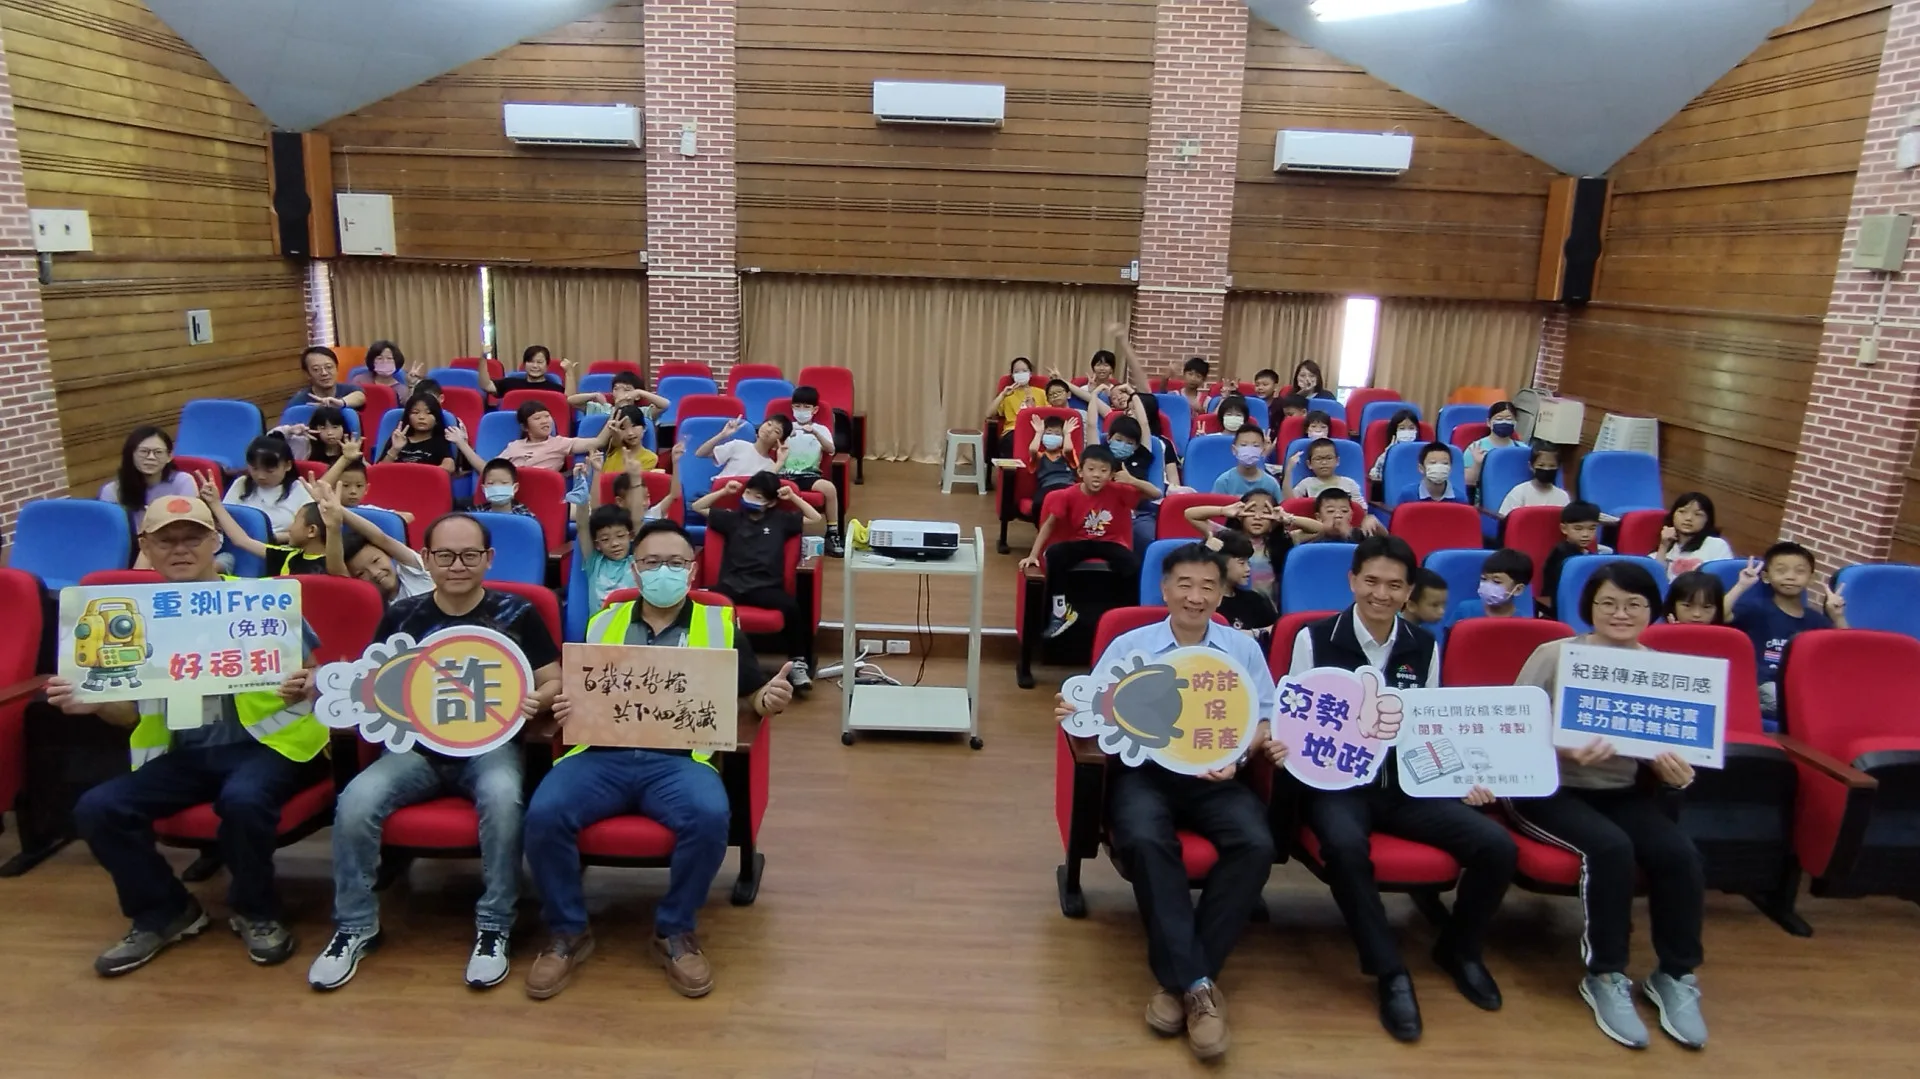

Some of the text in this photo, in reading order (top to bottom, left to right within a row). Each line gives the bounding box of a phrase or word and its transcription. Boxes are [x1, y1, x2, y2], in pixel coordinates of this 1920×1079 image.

[152, 589, 293, 619] 重測Free
[228, 618, 288, 638] (免費)
[168, 648, 281, 681] 好福利
[1571, 662, 1712, 695] 紀錄傳承認同感
[433, 655, 503, 725] 詐
[1191, 669, 1240, 692] 防詐
[1203, 698, 1227, 721] 保
[1411, 703, 1532, 718] 本所已開放檔案應用
[1577, 694, 1700, 724] 測區文史作紀實
[1192, 726, 1239, 750] 房產
[1576, 710, 1698, 741] 培力體驗無極限
[1301, 731, 1375, 780] 地政
